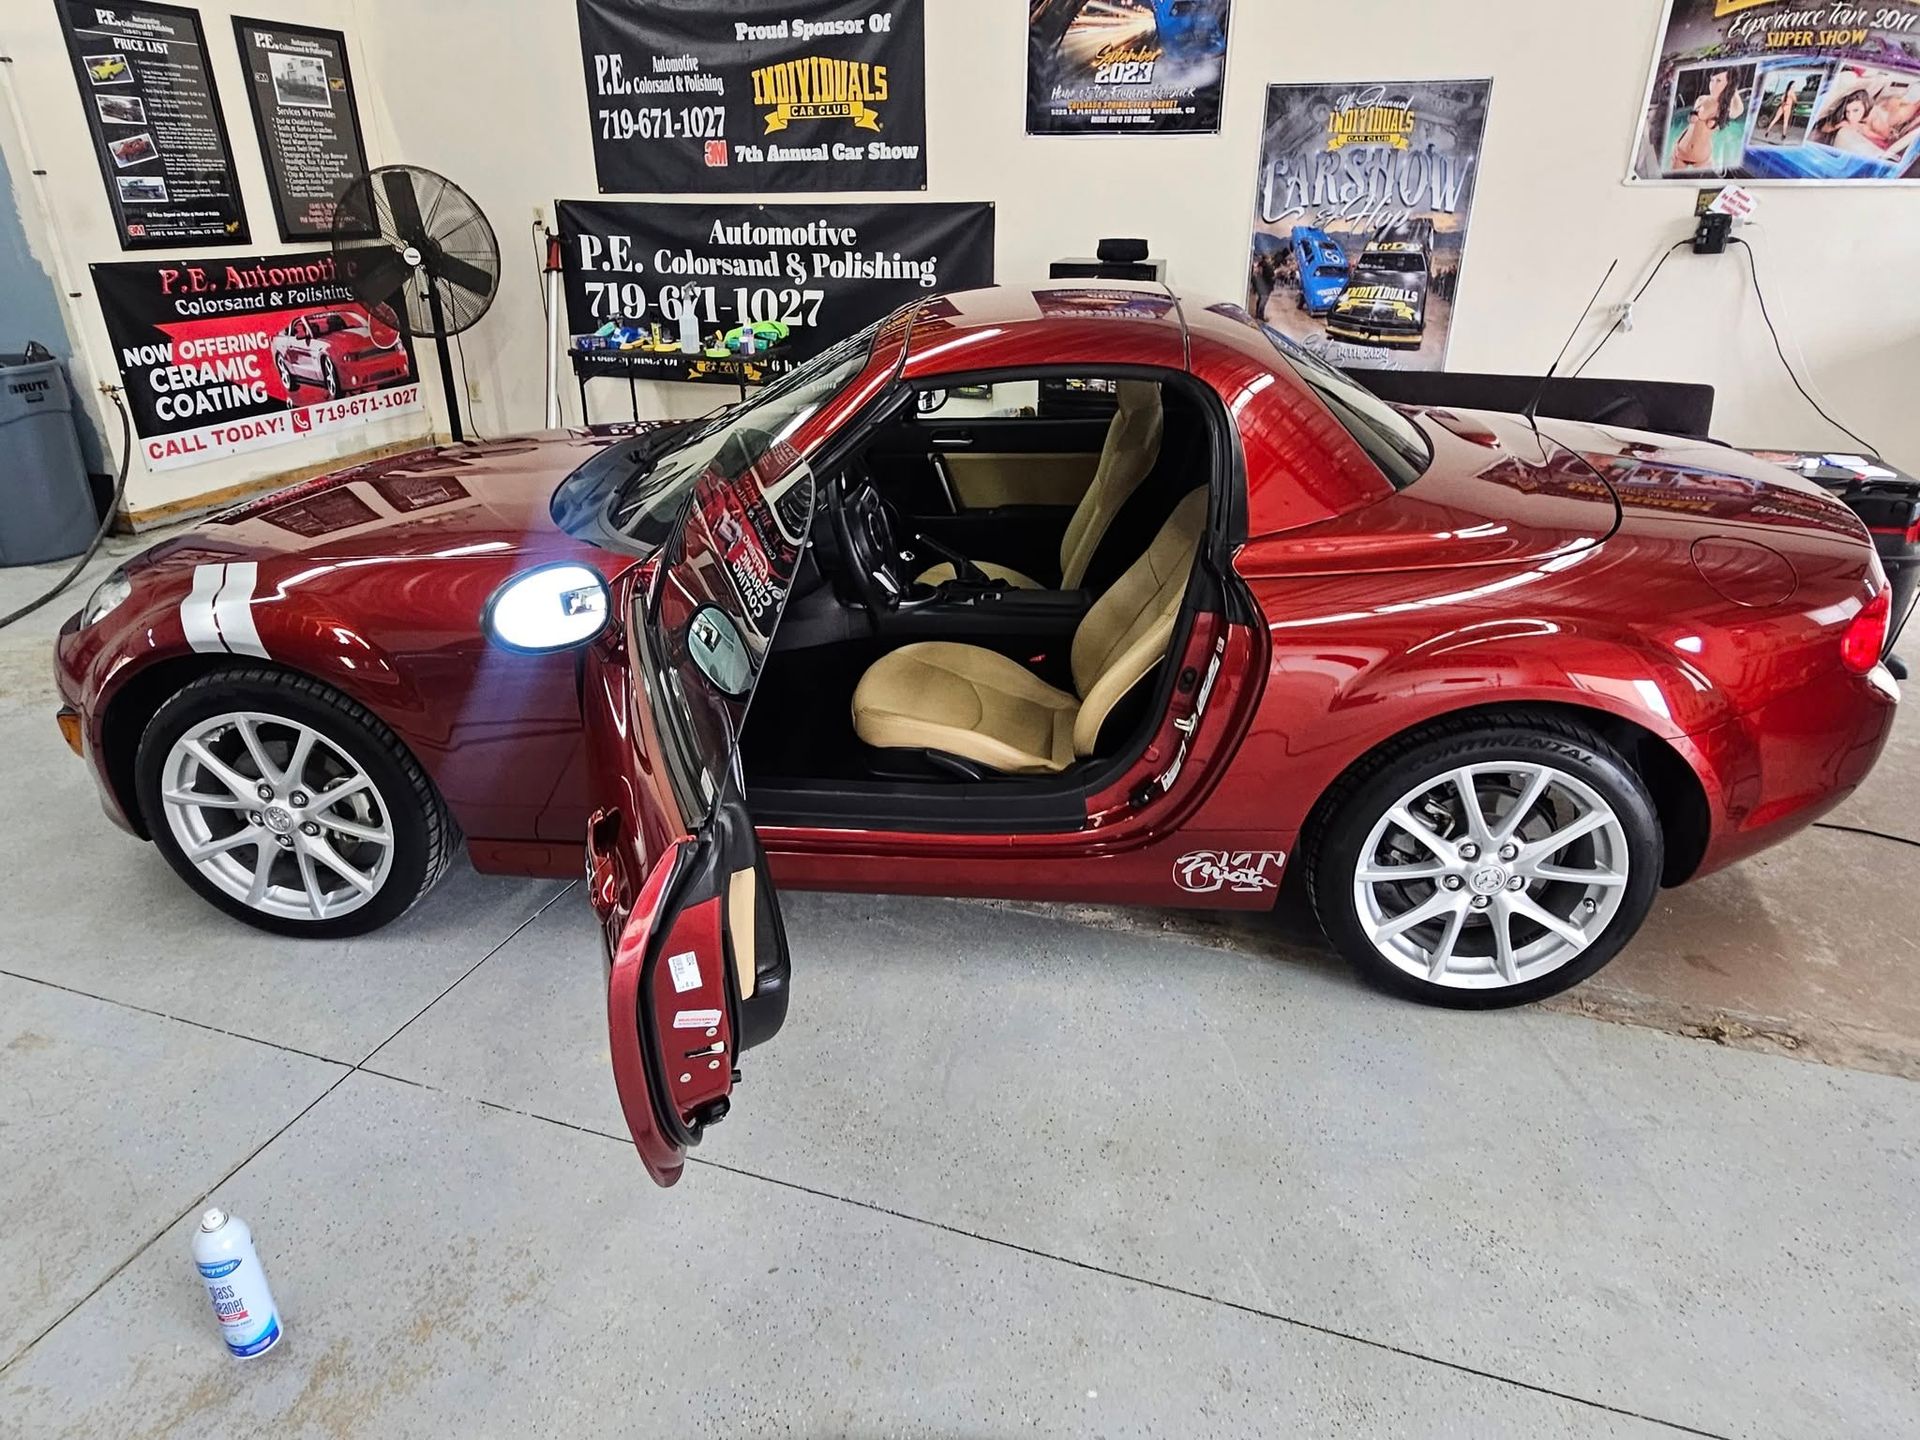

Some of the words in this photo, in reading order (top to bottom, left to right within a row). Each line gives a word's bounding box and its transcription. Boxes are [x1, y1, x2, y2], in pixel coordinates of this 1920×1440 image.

[95, 8, 122, 27] P.E.
[735, 20, 788, 41] Proud
[792, 17, 865, 41] Sponsor
[869, 13, 892, 33] Of
[1727, 9, 1826, 44] Experience
[1828, 2, 1868, 26] Tour
[112, 37, 145, 51] PRICE
[146, 41, 169, 54] LIST
[254, 31, 280, 50] P.E.
[1766, 29, 1815, 48] SUPER
[1816, 28, 1869, 47] SHOW
[652, 54, 699, 73] Automotive
[1091, 44, 1164, 68] September
[594, 54, 632, 95] P.E.
[633, 75, 675, 94] Colorsand
[675, 75, 685, 92] &
[684, 73, 725, 96] Polishing
[752, 56, 888, 105] INDIVIDUALS
[1095, 61, 1155, 84] 2023
[277, 106, 301, 117] Services
[301, 108, 312, 117] We
[791, 106, 815, 116] CAR
[818, 104, 850, 115] CLUB
[1356, 85, 1415, 113] Annual
[599, 106, 726, 139] 719-671-1027
[1328, 107, 1416, 133] INDIVIDUALS
[704, 139, 728, 167] 3M
[735, 146, 764, 162] 7th
[767, 143, 829, 162] Annual
[832, 144, 865, 161] Car
[868, 142, 919, 160] Show
[1340, 192, 1411, 240] Hop
[708, 218, 857, 247] Automotive
[577, 234, 644, 274] P.E.
[653, 248, 780, 278] Colorsand
[786, 252, 808, 286] &
[812, 251, 937, 288] Polishing
[158, 267, 217, 295] P.E.
[225, 256, 358, 291] Automotie
[175, 293, 265, 316] Colorsand
[269, 290, 284, 307] &
[1346, 285, 1419, 303] INDIVIDUALS
[122, 342, 174, 368] NOW
[178, 331, 270, 360] OFFERING
[8, 380, 50, 394] BRUTE
[149, 354, 262, 393] CERAMIC
[155, 380, 269, 421] COATING
[148, 434, 208, 460] CALL
[210, 416, 286, 446] TODAY!
[1411, 734, 1593, 771] CONTINENTAL
[1177, 856, 1277, 888] Miata
